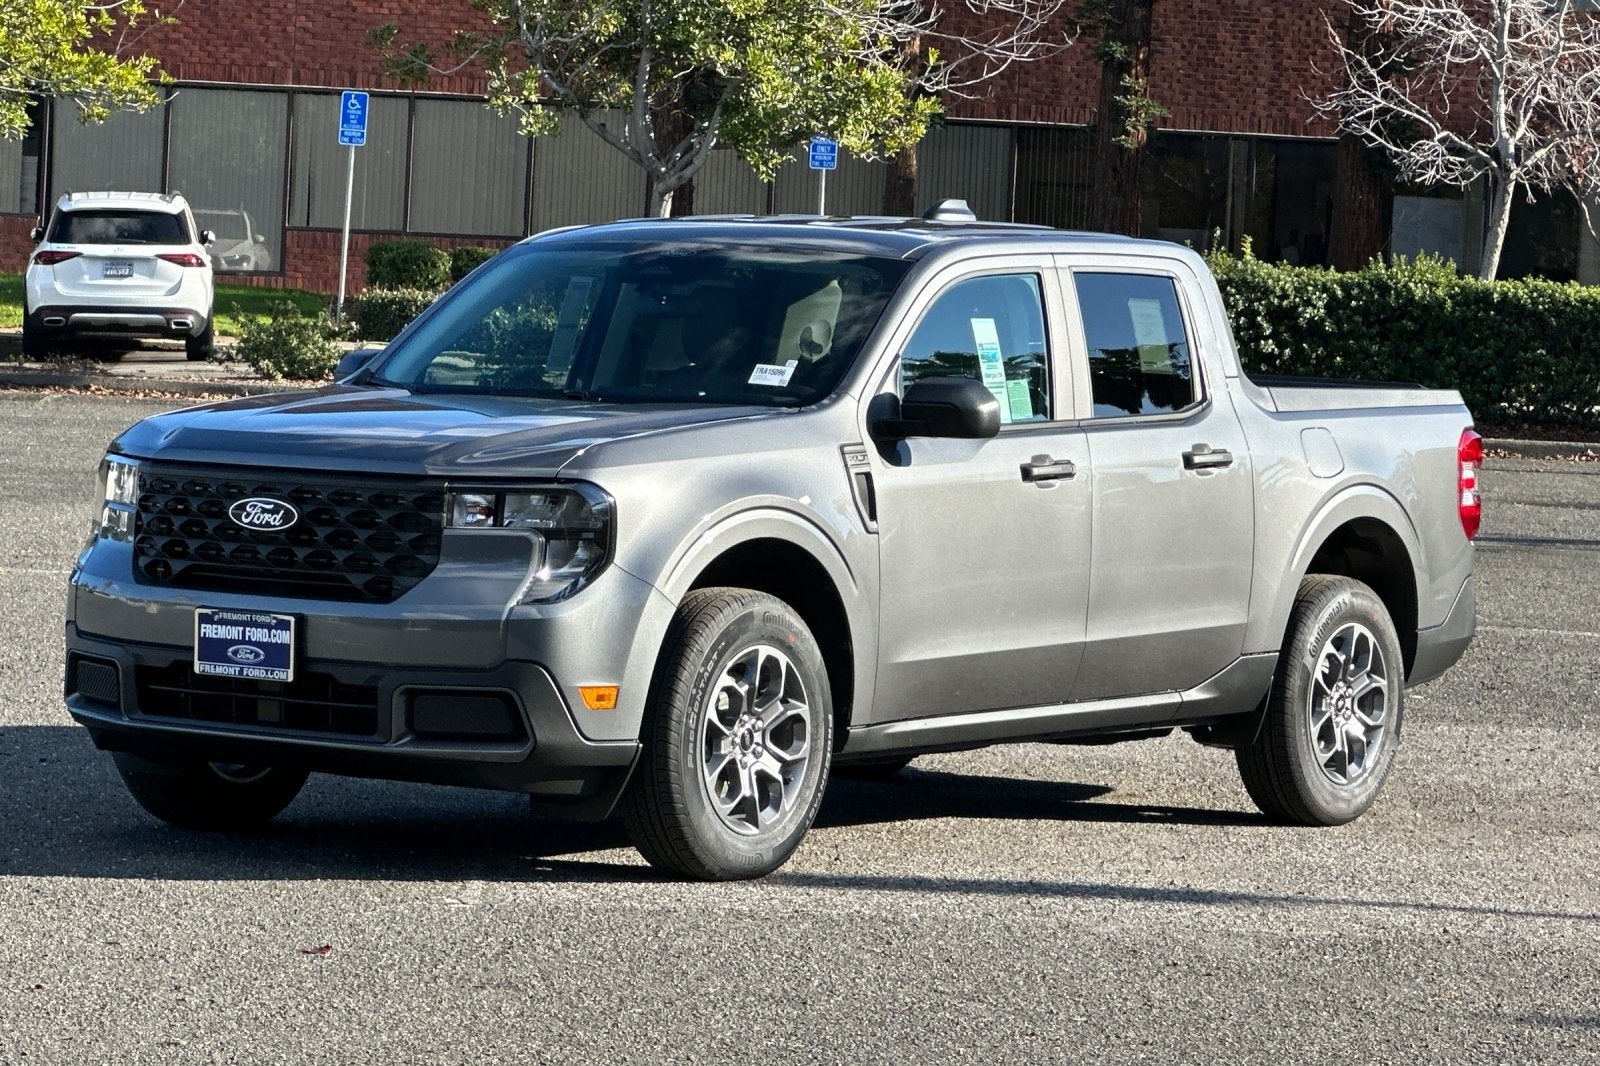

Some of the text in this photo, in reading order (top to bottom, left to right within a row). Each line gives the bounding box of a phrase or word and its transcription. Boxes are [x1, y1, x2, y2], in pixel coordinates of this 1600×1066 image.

[241, 501, 284, 526] Ford
[218, 612, 271, 623] FREMONT FORD
[200, 624, 290, 644] FREMONT FORD.COM
[1308, 604, 1344, 658] Continental
[236, 648, 256, 660] Ford
[200, 662, 288, 680] FREMONT FORD.COM
